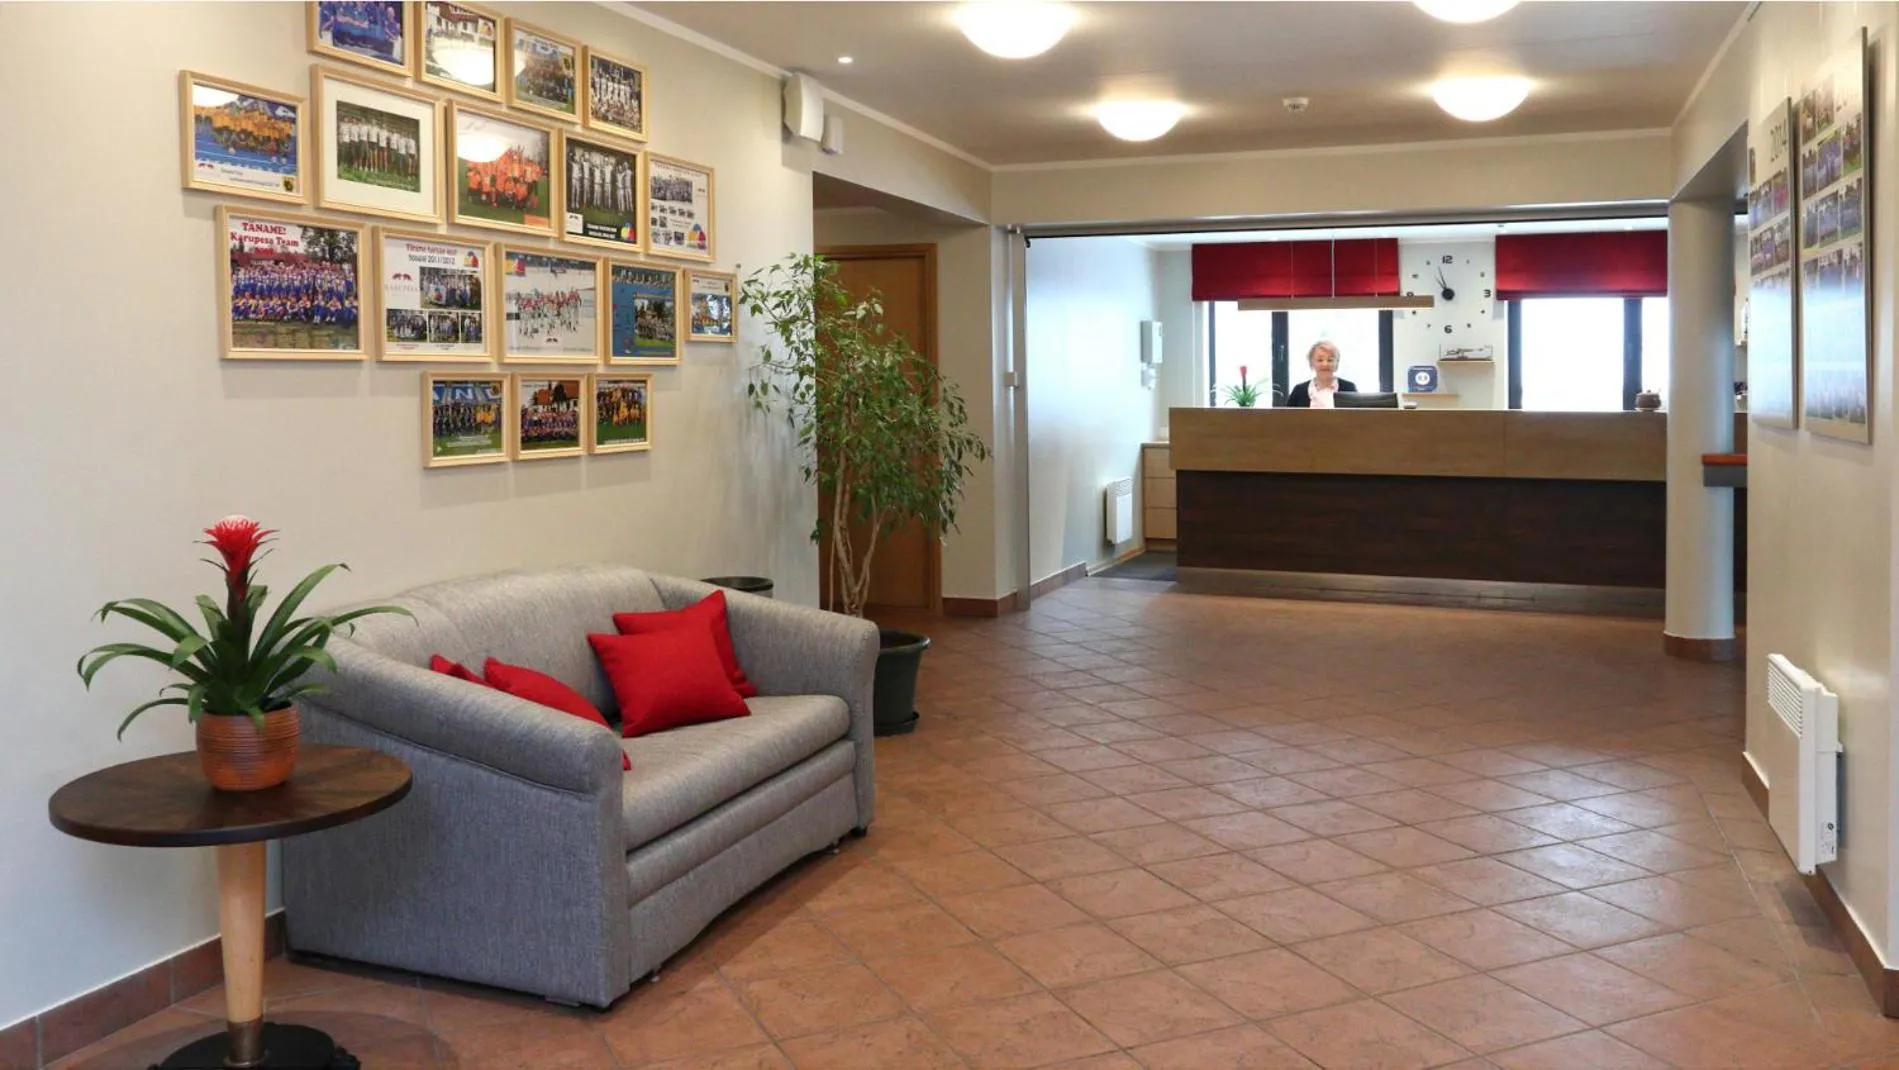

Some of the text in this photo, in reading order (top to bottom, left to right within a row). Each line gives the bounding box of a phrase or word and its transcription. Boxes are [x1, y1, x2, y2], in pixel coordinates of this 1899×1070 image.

[276, 236, 300, 248] Team
[1442, 255, 1453, 265] 12
[1484, 289, 1492, 298] 3
[1444, 325, 1453, 334] 6
